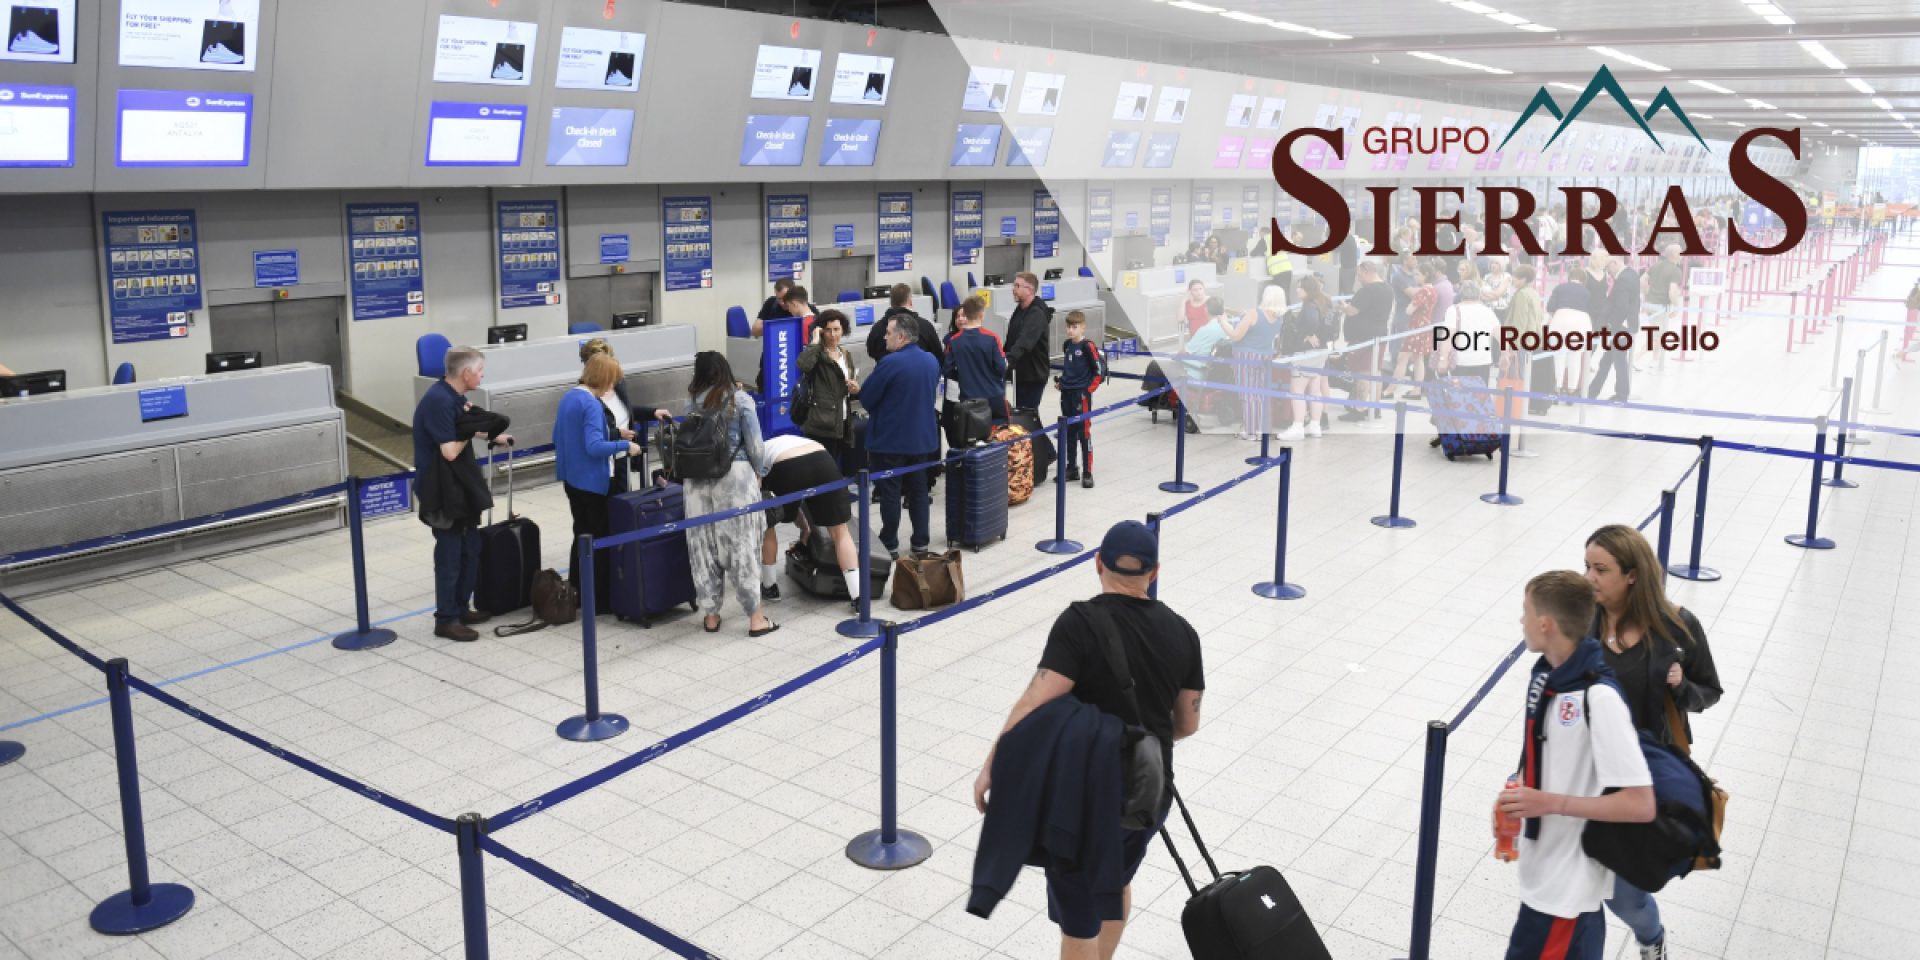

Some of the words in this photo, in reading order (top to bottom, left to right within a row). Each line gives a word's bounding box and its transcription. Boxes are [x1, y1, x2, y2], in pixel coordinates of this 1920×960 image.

[566, 126, 597, 136] Check-in
[108, 215, 145, 224] Important
[146, 214, 190, 222] Information
